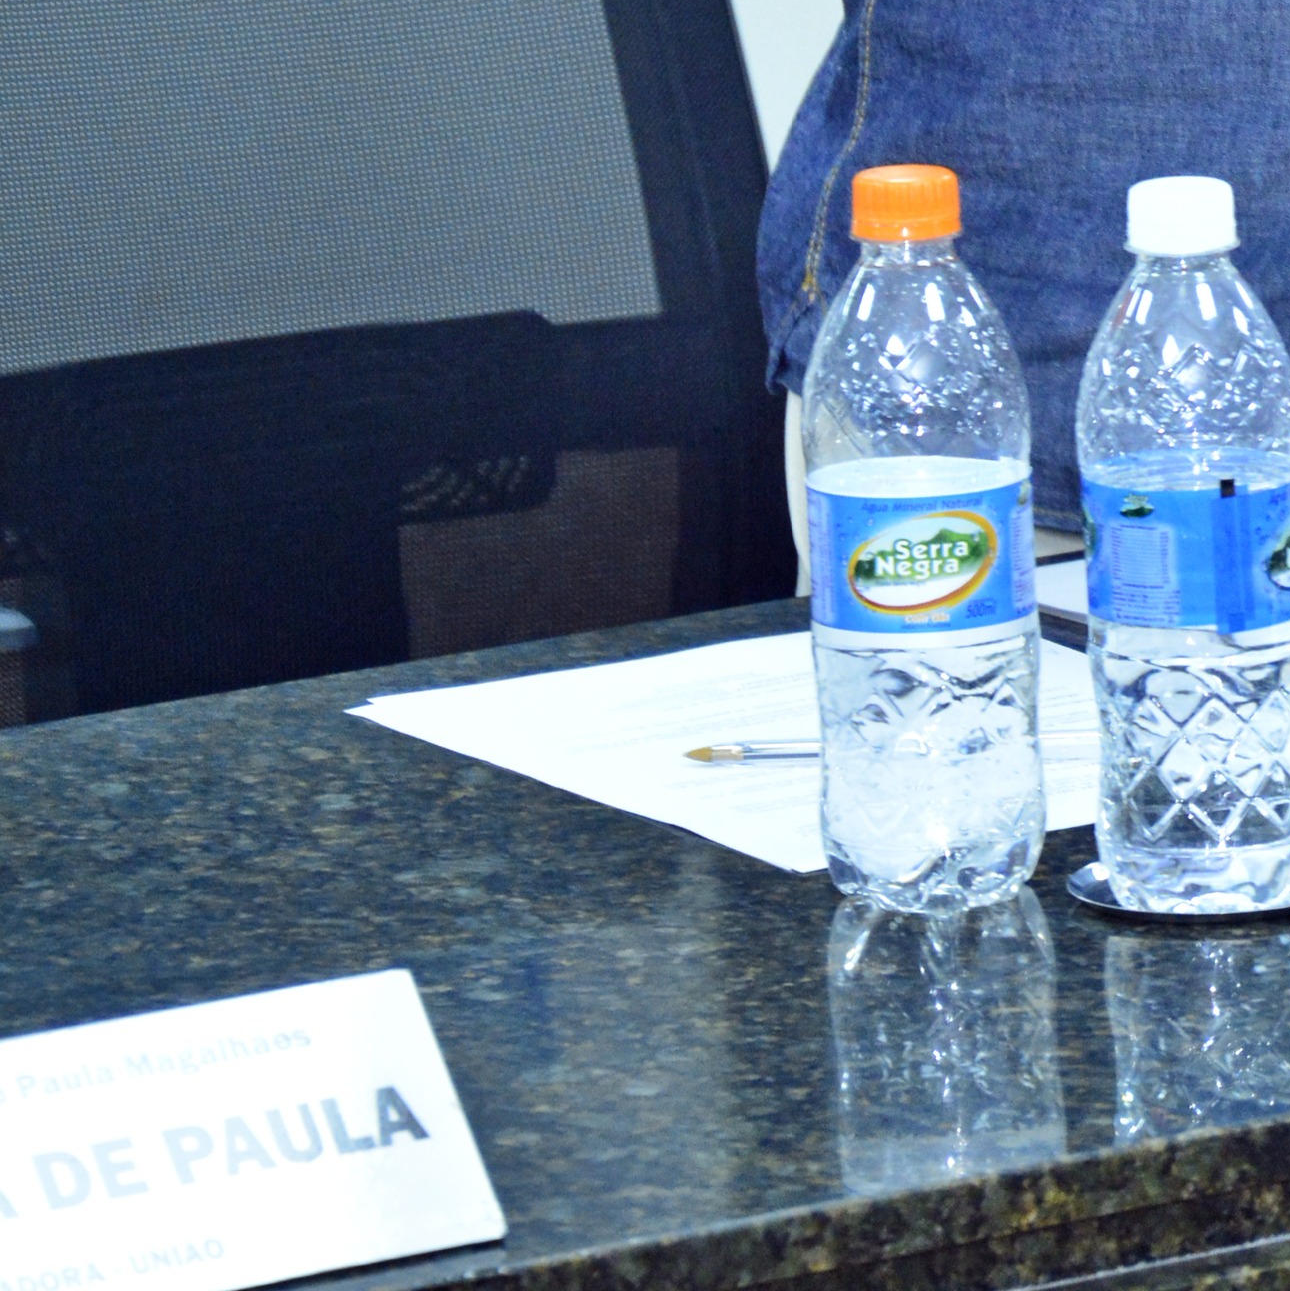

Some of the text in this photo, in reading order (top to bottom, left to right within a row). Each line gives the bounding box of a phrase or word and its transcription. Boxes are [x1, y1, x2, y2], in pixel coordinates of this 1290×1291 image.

[894, 538, 970, 560] Serra
[874, 555, 960, 580] Negra
[16, 1062, 116, 1099] Paula
[32, 1136, 150, 1210] DE
[161, 1083, 432, 1186] PAULA
